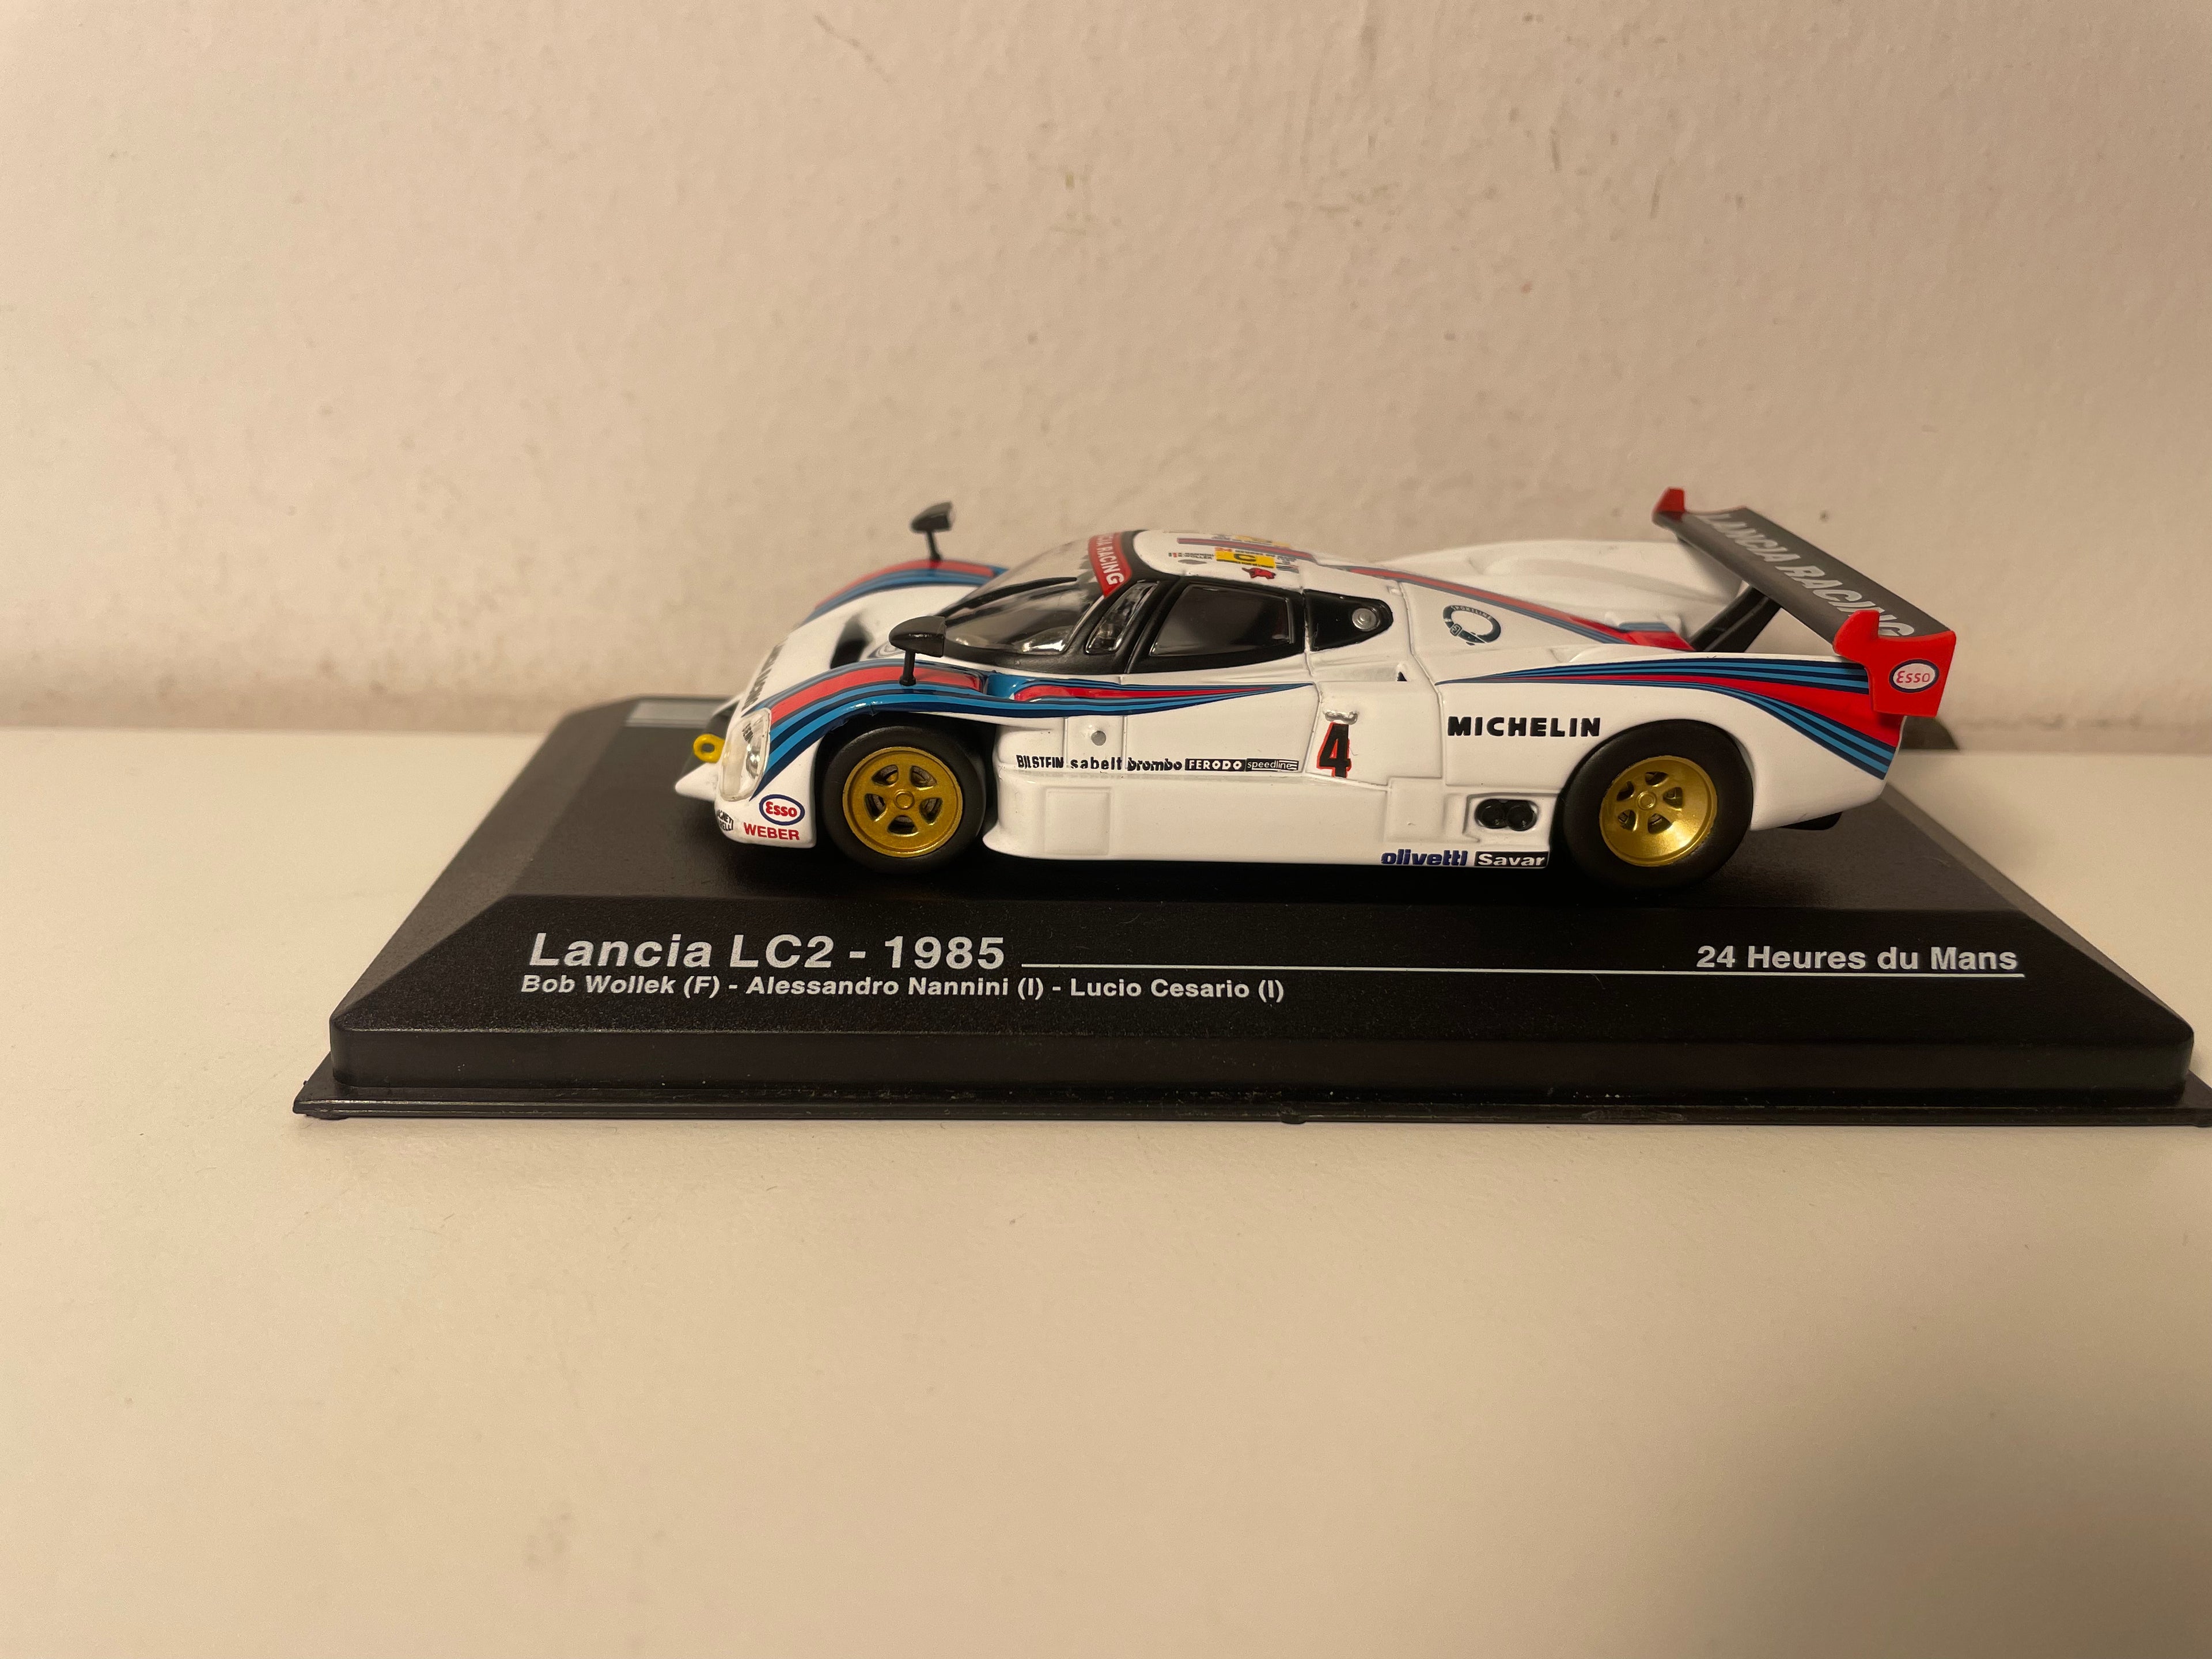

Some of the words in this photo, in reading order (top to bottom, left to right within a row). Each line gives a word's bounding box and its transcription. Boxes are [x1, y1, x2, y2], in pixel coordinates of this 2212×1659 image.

[1097, 547, 1124, 585] RACING
[1448, 717, 1600, 737] MICHELIN
[1317, 722, 1351, 778] 4
[1070, 756, 1122, 770] sabelt
[1188, 760, 1242, 770] FERODO
[1247, 760, 1297, 770] speedline
[744, 822, 800, 840] WEBER
[1382, 849, 1468, 866] olivetti
[1478, 854, 1546, 866] Savar
[529, 933, 711, 967] Lancia
[730, 934, 834, 968] LC2
[885, 936, 1003, 969] 1985
[1696, 946, 1735, 968] 24
[1748, 946, 1866, 969] Heures
[1877, 947, 1918, 969] du
[1931, 947, 2018, 969] Mans
[521, 975, 575, 993] Bob
[586, 975, 676, 993] Wollek
[684, 976, 719, 998] (F)
[746, 976, 899, 994] Alessandro
[908, 977, 1008, 995] Nannini
[1018, 978, 1043, 1000] (I)
[1071, 979, 1141, 996] Lucio
[1151, 979, 1249, 997] Cesario
[1259, 980, 1283, 1002] (I)
